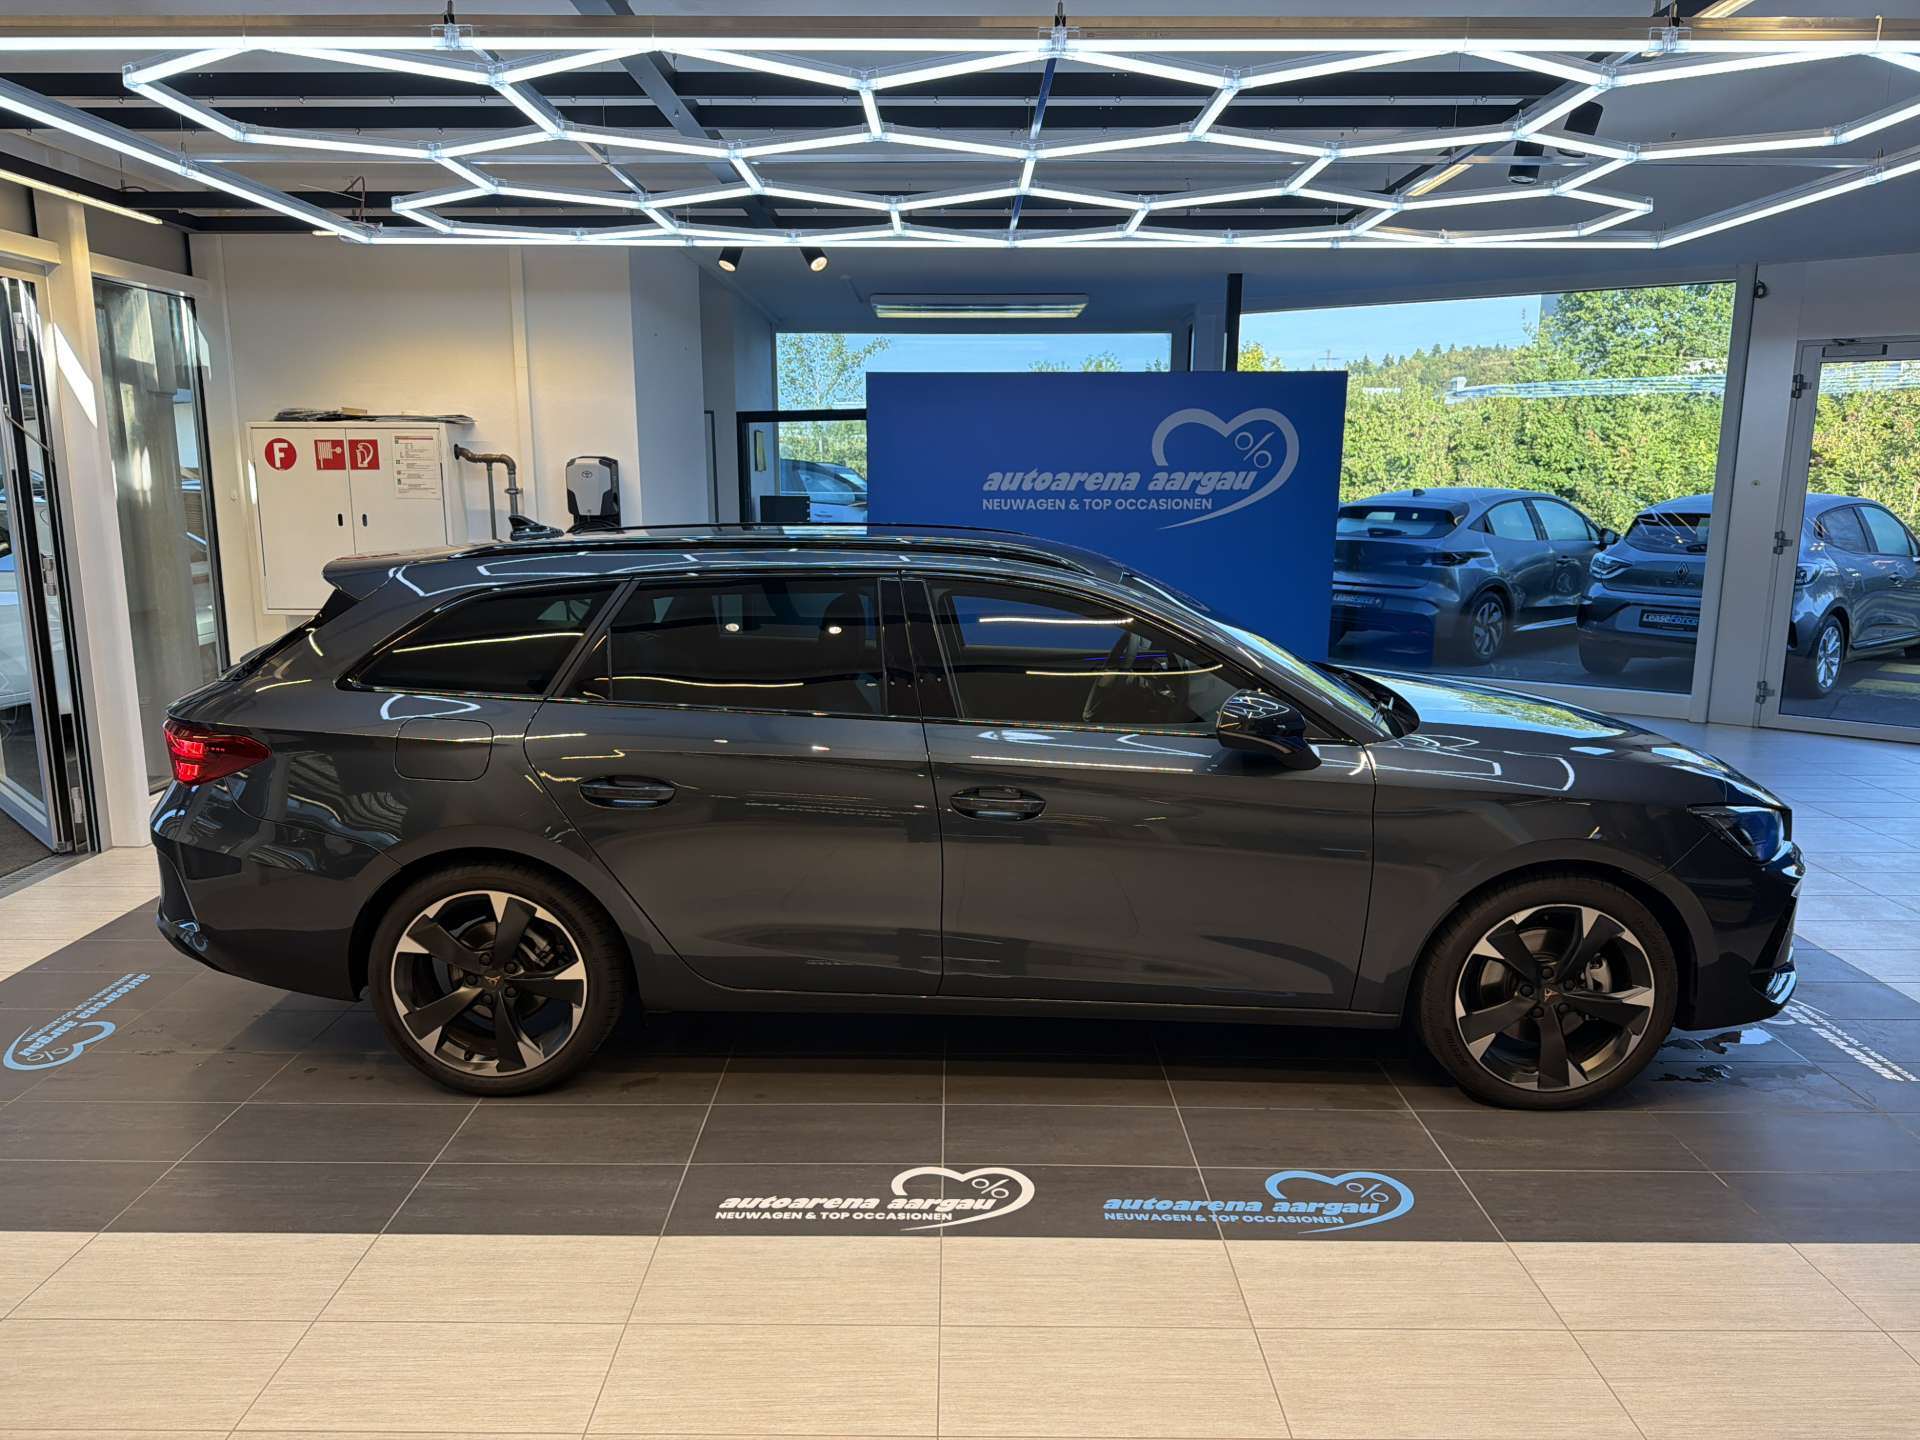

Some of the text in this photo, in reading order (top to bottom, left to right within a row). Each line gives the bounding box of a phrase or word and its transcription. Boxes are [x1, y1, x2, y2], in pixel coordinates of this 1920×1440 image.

[272, 442, 289, 468] F
[982, 468, 1258, 495] autoarena aargau
[982, 498, 1213, 511] NEUWAGEN & TOP OCCASIONEN
[719, 1196, 997, 1213] autoarena aargau
[1103, 1198, 1380, 1216] autoarena aargau
[715, 1212, 952, 1221] NEUWAGEN & TOP OCCASIONEN
[1104, 1212, 1344, 1225] NEUWAGEN & TOP OCCASIONEN
